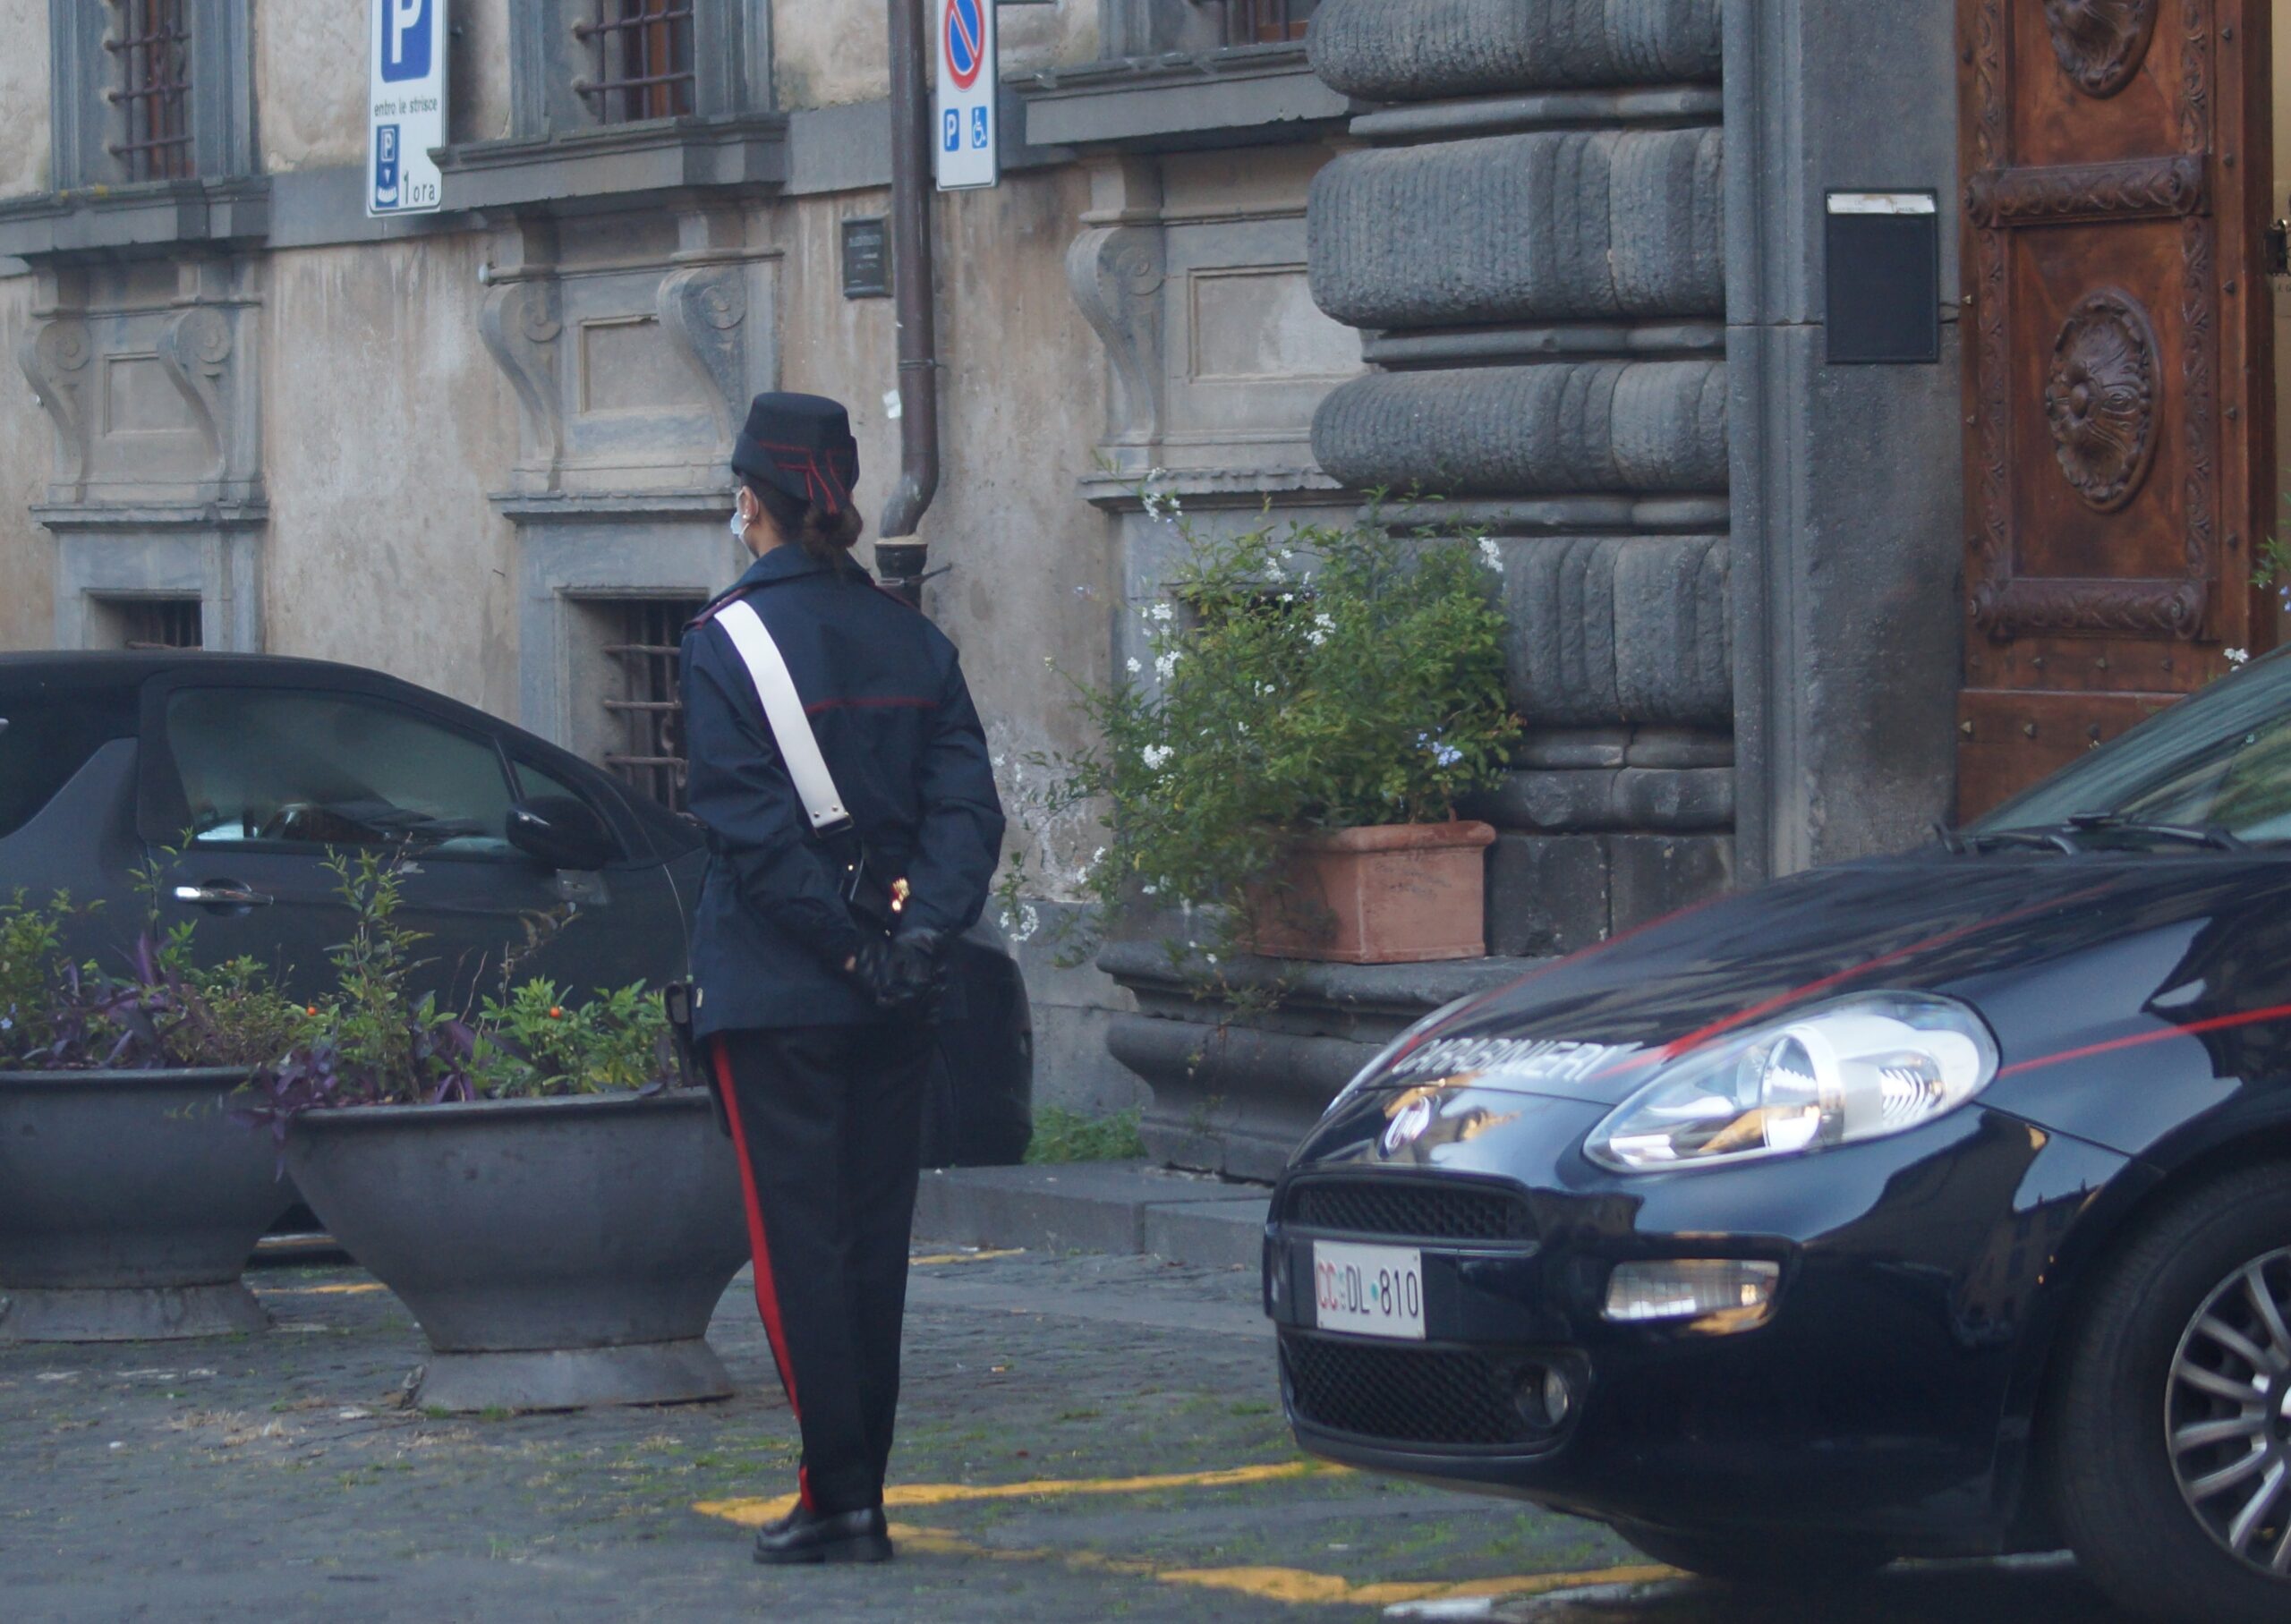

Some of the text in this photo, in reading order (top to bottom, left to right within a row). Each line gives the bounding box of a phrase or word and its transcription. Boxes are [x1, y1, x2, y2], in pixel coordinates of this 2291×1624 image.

[392, 0, 422, 64] P
[374, 93, 438, 116] entro le strisce
[384, 132, 394, 158] P
[946, 113, 958, 148] P
[404, 170, 435, 205] 1 ora
[1379, 1268, 1419, 1319] 810
